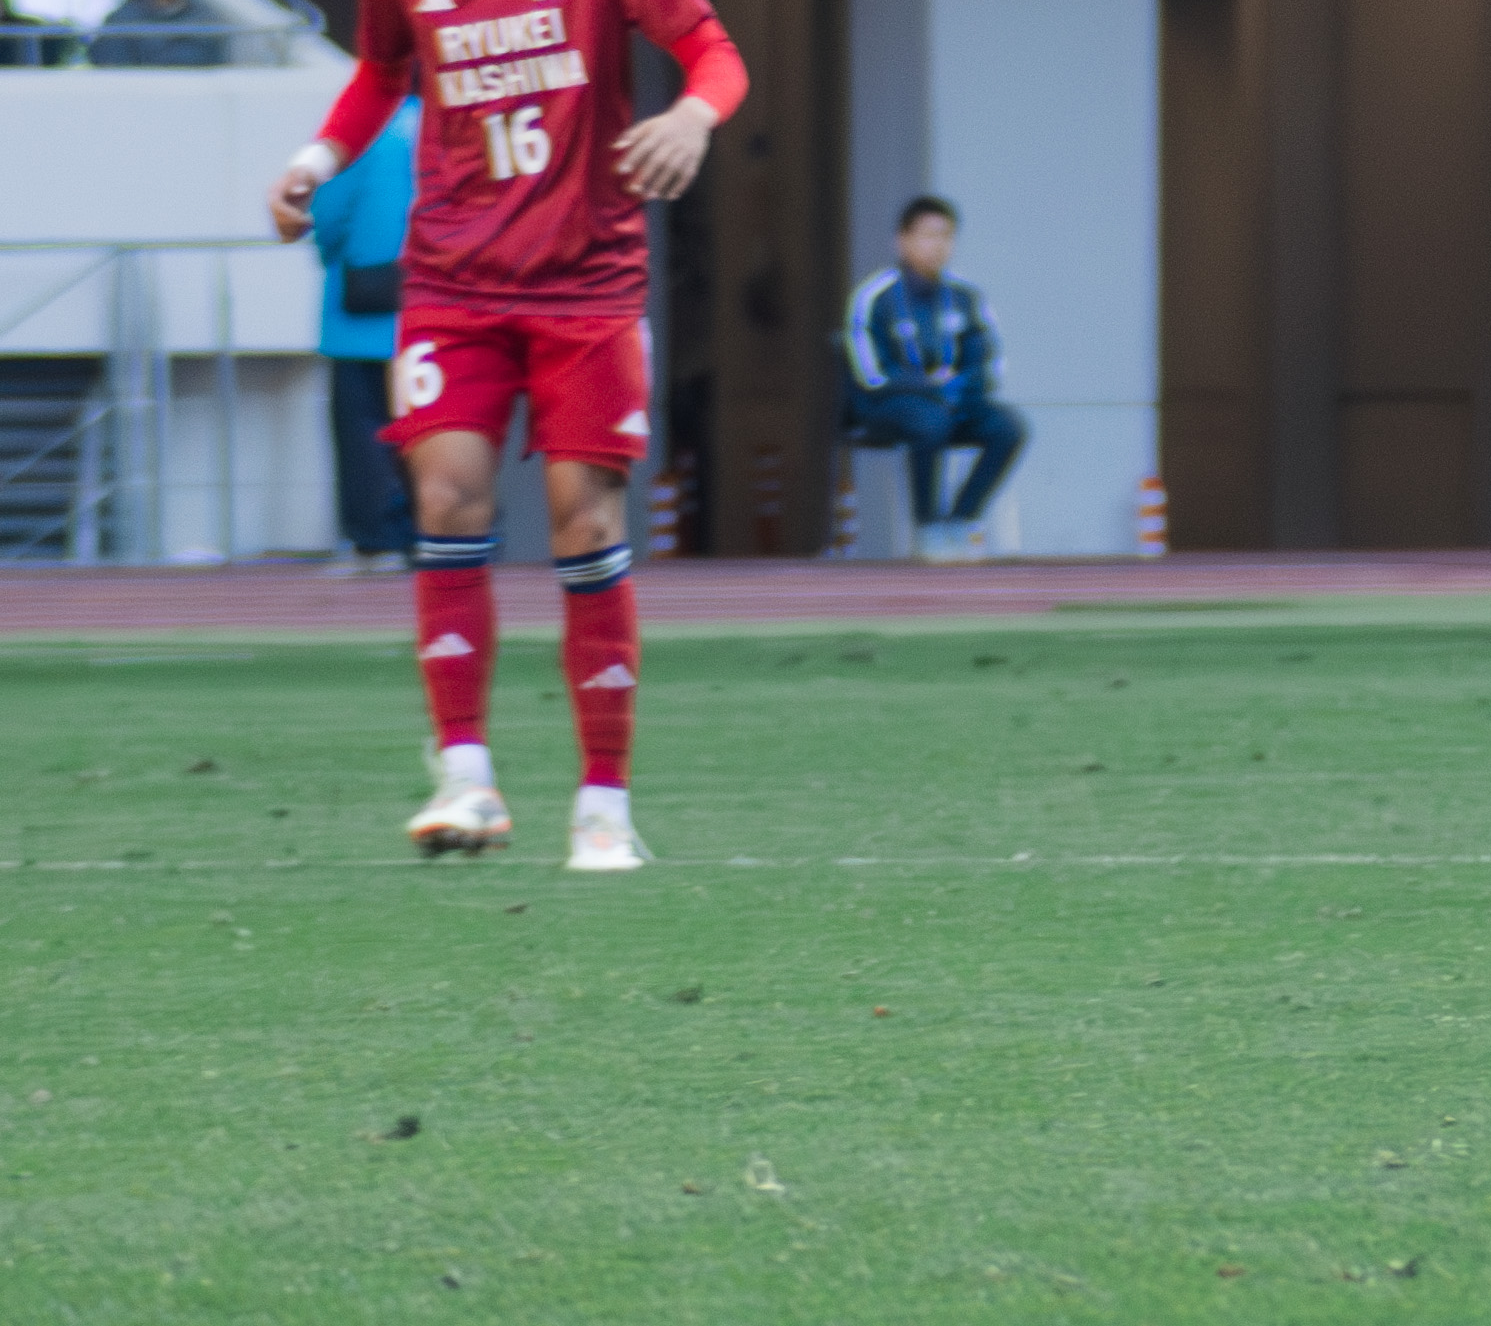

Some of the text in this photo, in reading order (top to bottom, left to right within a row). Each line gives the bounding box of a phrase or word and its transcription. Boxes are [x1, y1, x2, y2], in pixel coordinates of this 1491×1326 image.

[436, 7, 567, 65] RYUKEI
[437, 49, 589, 108] KASHIWA
[484, 104, 552, 181] 16
